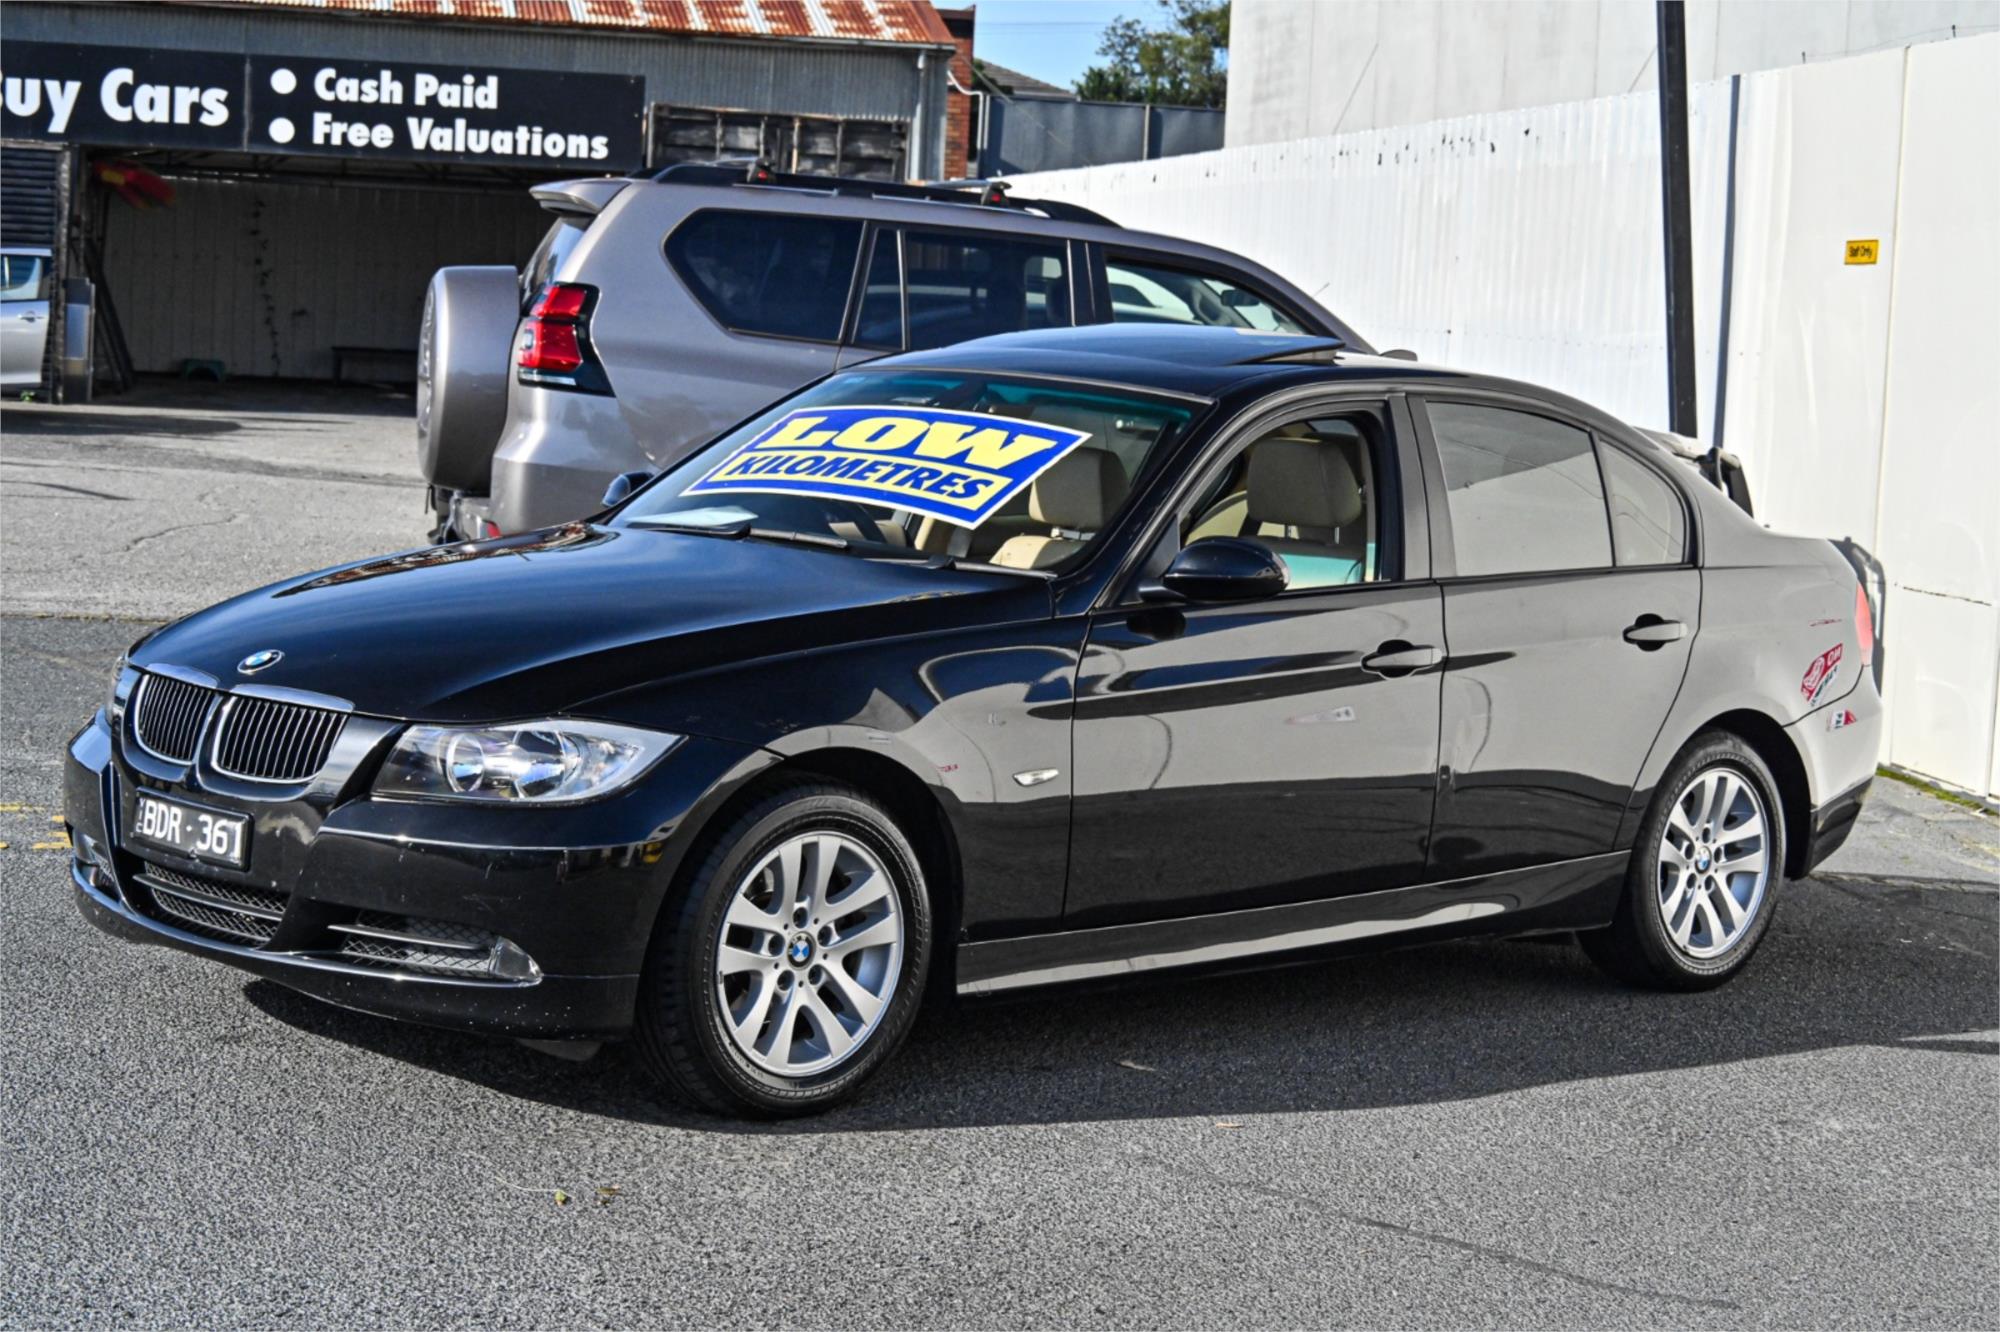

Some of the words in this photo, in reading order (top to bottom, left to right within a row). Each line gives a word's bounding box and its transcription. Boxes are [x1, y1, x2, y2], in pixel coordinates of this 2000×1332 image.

[0, 69, 82, 133] uy
[101, 67, 230, 127] Cars
[314, 67, 404, 105] Cash
[414, 73, 499, 110] Paid
[312, 112, 395, 149] Free
[407, 117, 610, 160] Valuations
[755, 416, 1058, 471] LOW
[725, 455, 992, 500] KILOMETRES
